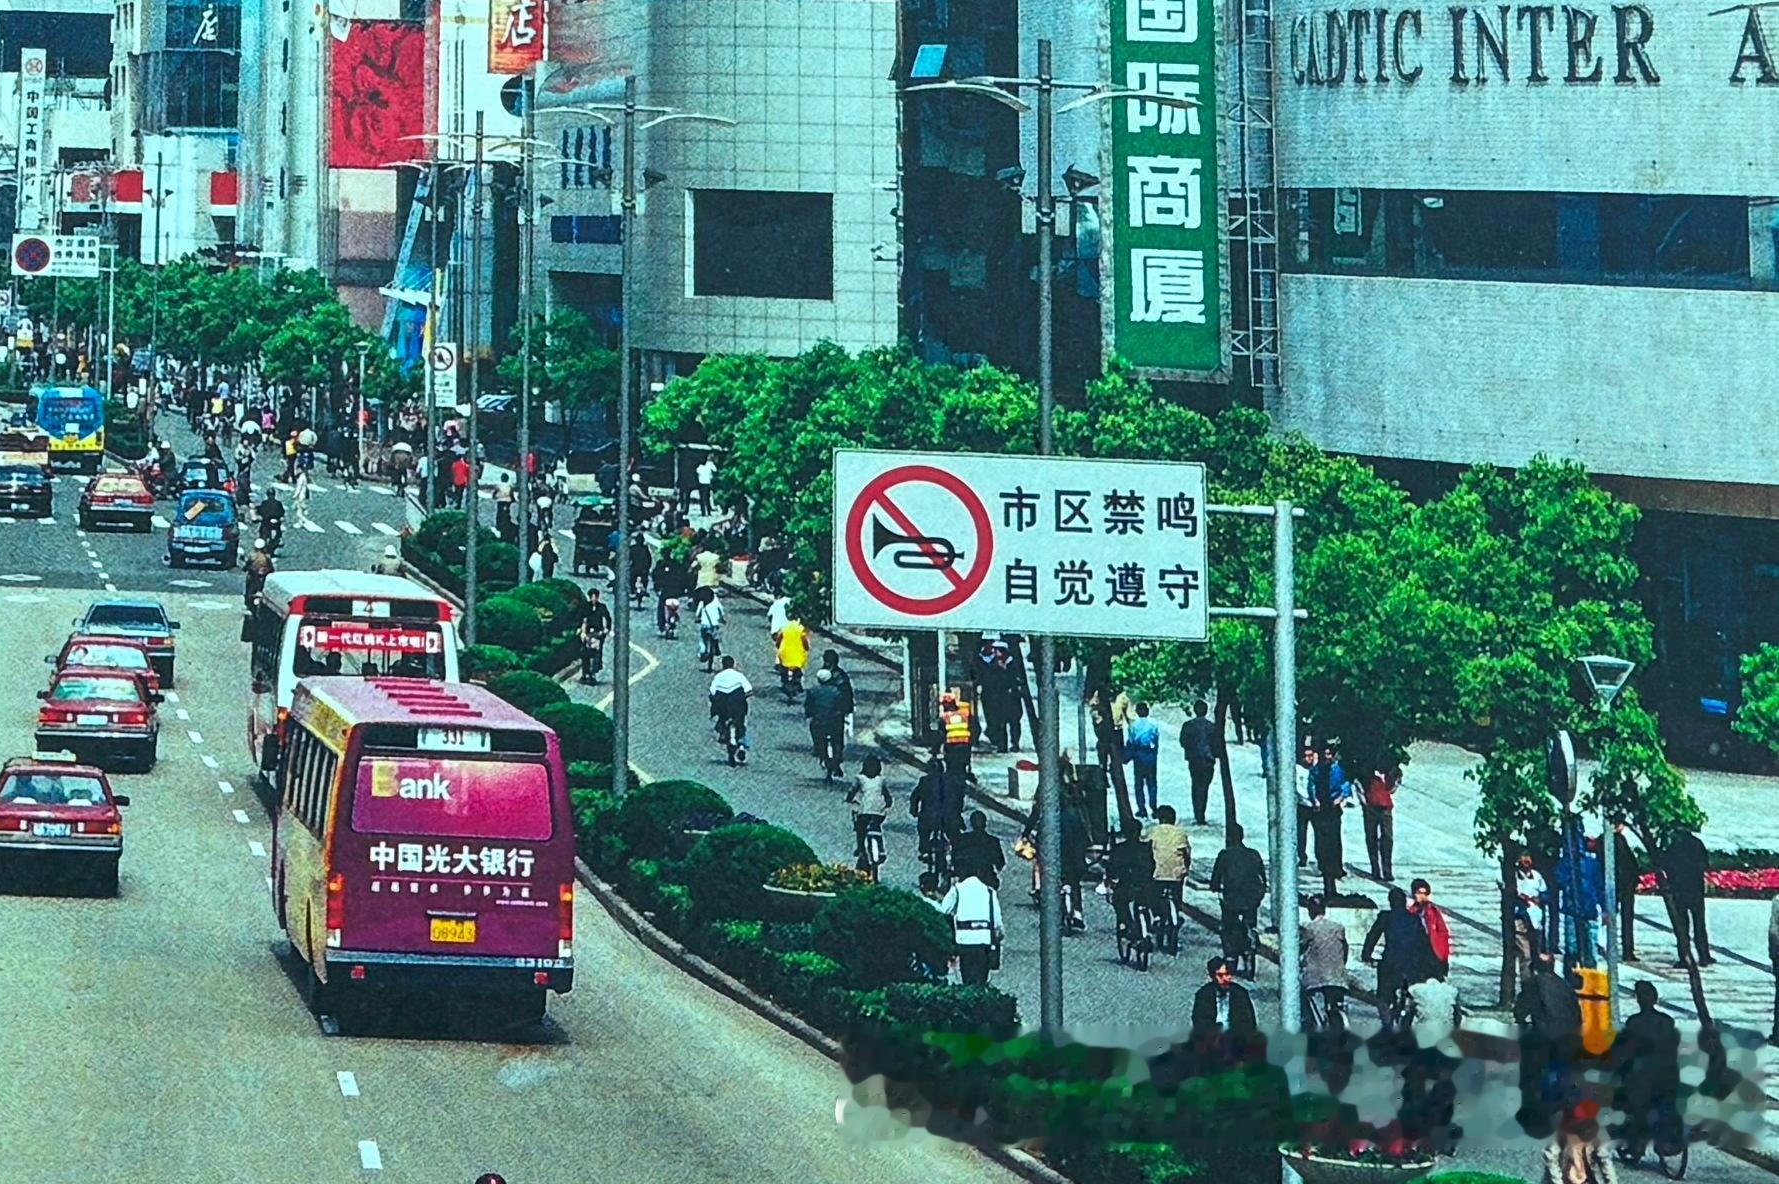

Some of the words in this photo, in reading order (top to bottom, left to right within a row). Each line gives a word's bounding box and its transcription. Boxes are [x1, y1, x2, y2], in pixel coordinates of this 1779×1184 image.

[1290, 6, 1424, 86] CADTIC
[1449, 3, 1661, 86] INTER
[997, 484, 1201, 541] 市区禁鸣
[1003, 556, 1202, 612] 自觉遵守
[371, 760, 452, 801] Bank
[369, 841, 536, 878] 中国光大银行
